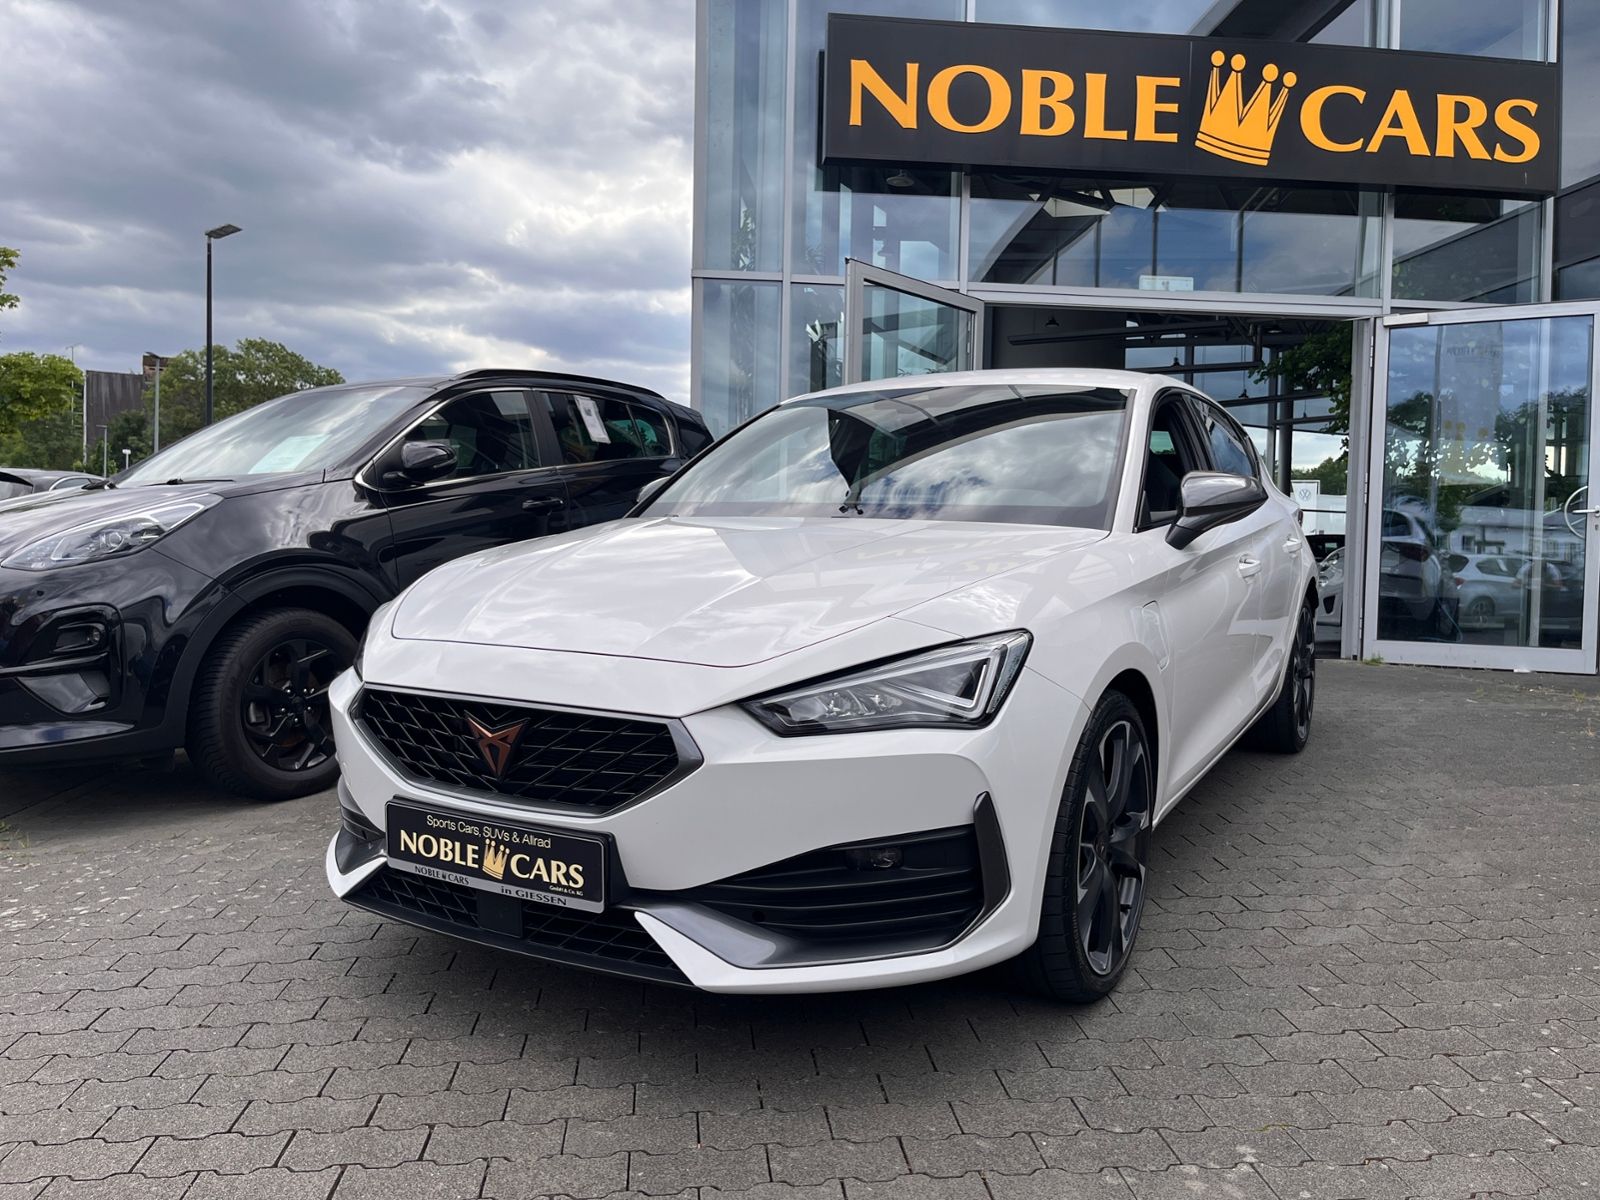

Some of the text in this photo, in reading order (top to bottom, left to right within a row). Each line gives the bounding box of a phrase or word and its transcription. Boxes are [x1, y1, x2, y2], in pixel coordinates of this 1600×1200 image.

[849, 59, 1541, 165] NOBLE CARS
[426, 815, 551, 848] Sports Cars, SUVs & Allrad
[400, 829, 584, 888] NOBLE CARS
[414, 865, 470, 885] NOBLE CARS
[500, 885, 567, 906] in GIESSEN
